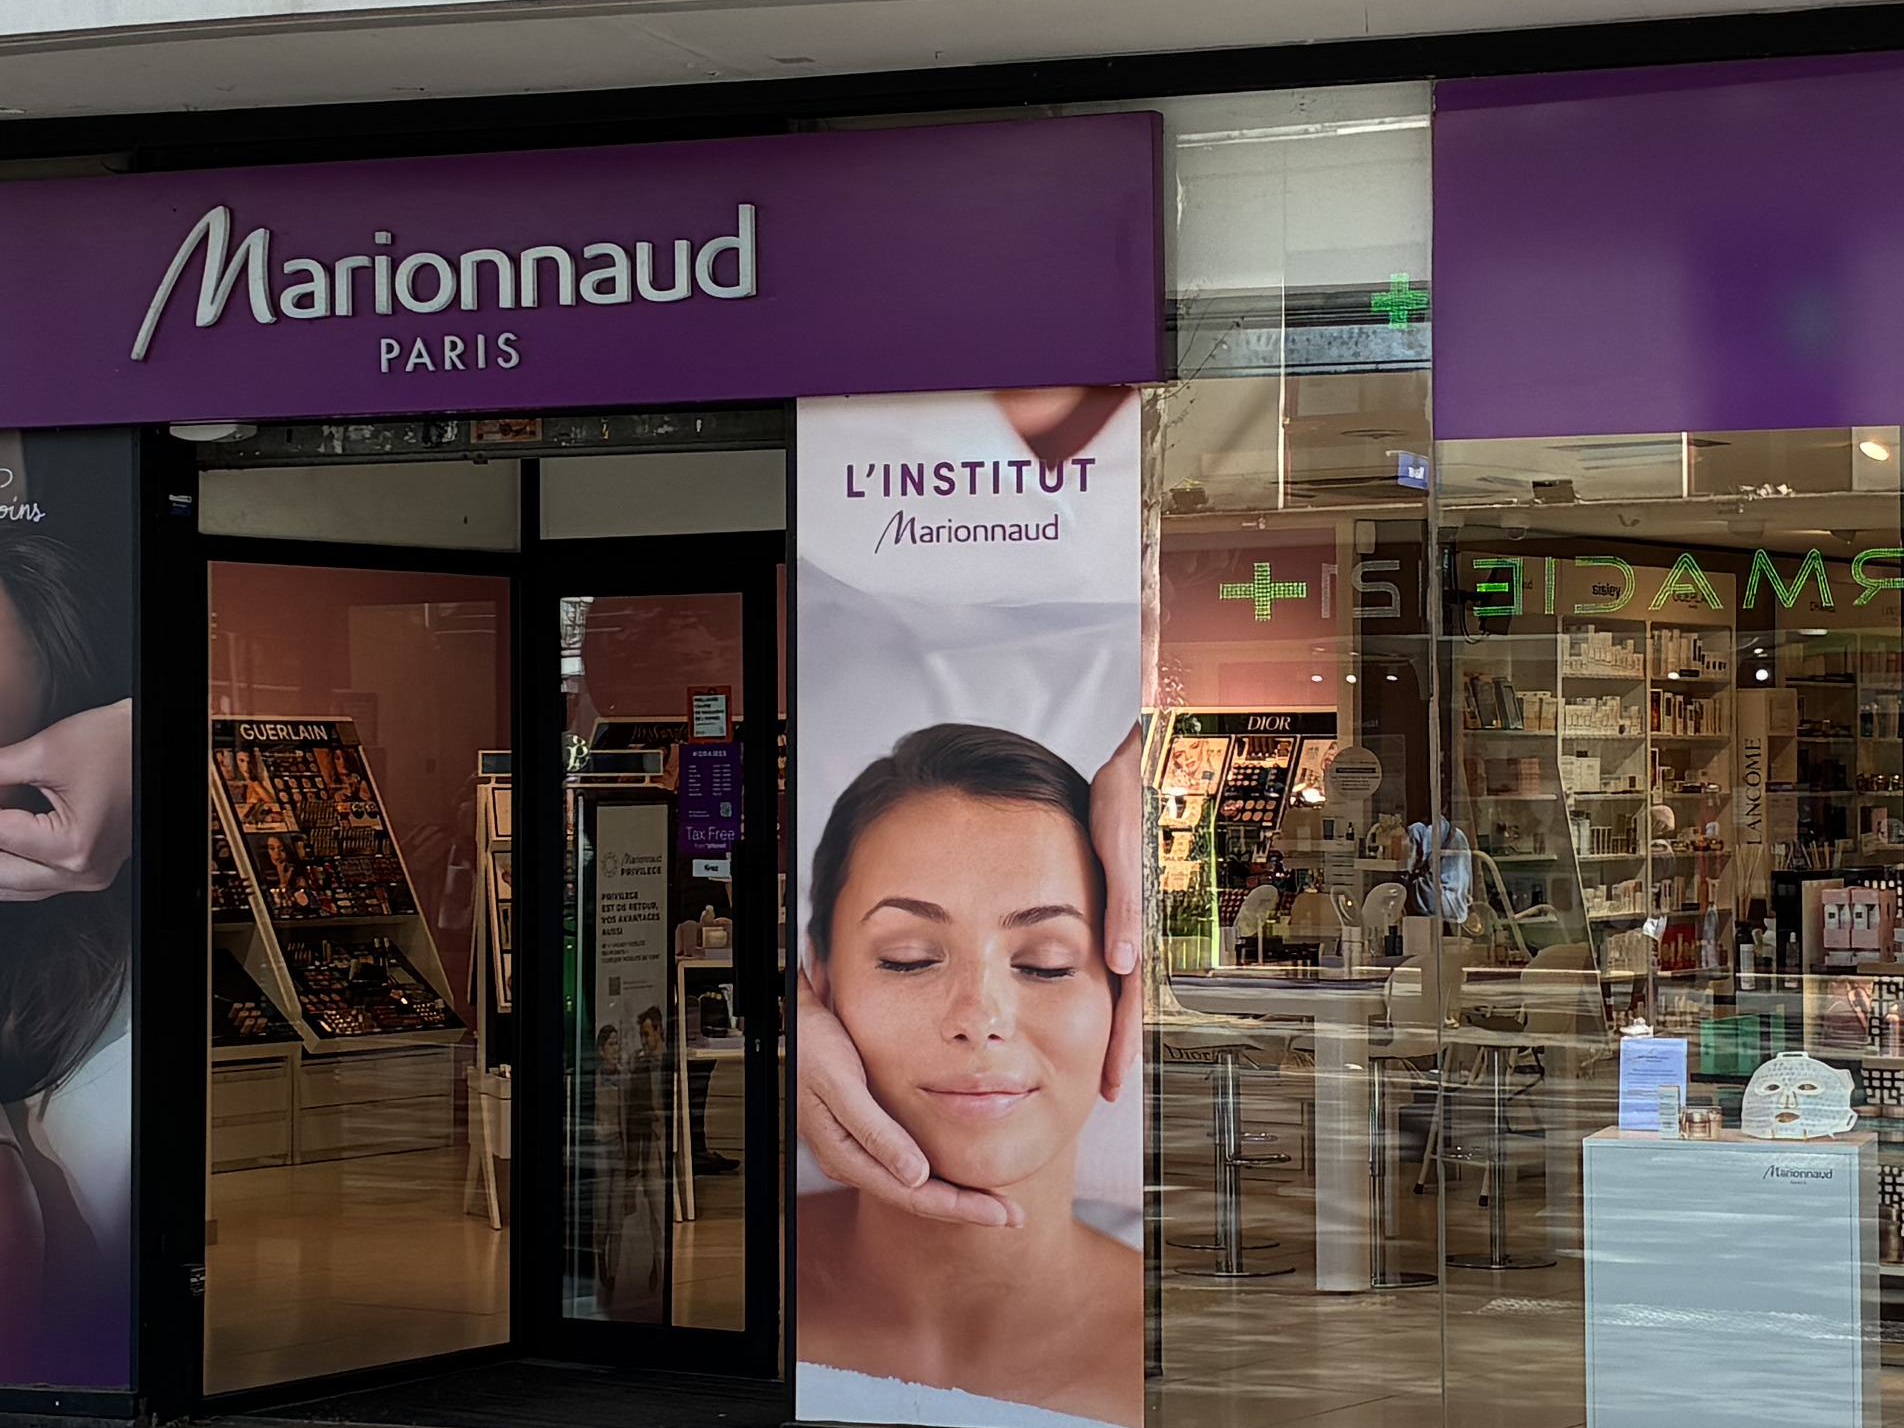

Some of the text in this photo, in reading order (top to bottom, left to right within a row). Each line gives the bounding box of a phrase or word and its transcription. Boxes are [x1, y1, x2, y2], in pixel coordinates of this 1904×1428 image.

[130, 203, 757, 362] Marionnaud
[380, 332, 520, 372] PARIS
[847, 458, 1096, 498] L'INSTITUT
[874, 510, 1059, 554] Marionnaud
[1592, 583, 1621, 599] sisley
[239, 723, 328, 741] GUERLAIN
[1247, 715, 1291, 731] DIOR
[1742, 737, 1762, 845] LANCÔME
[685, 826, 735, 841] Tax Free
[1763, 1164, 1834, 1179] Marionnaud
